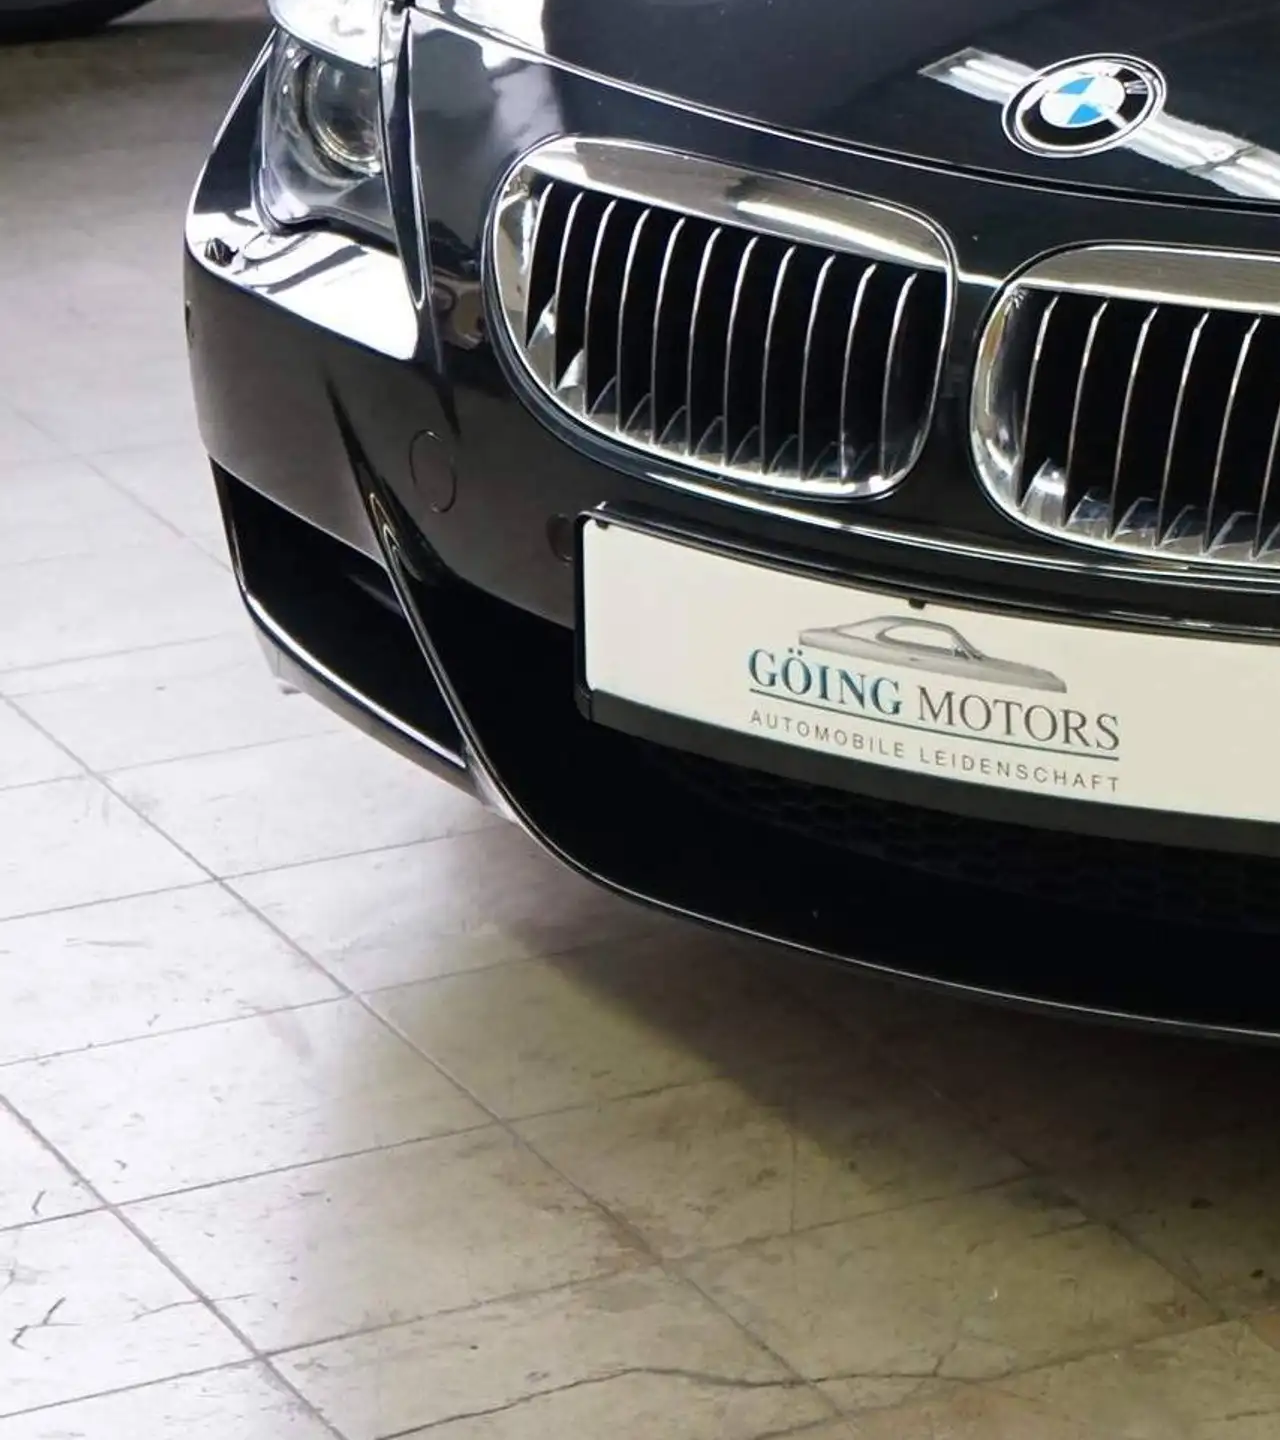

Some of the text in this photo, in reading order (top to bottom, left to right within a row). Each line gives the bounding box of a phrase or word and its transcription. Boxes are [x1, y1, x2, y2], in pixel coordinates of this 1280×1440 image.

[748, 648, 1119, 751] GÖING MOTORS
[750, 711, 1119, 792] AUTOMOBILE LEIDENSCHAFT
